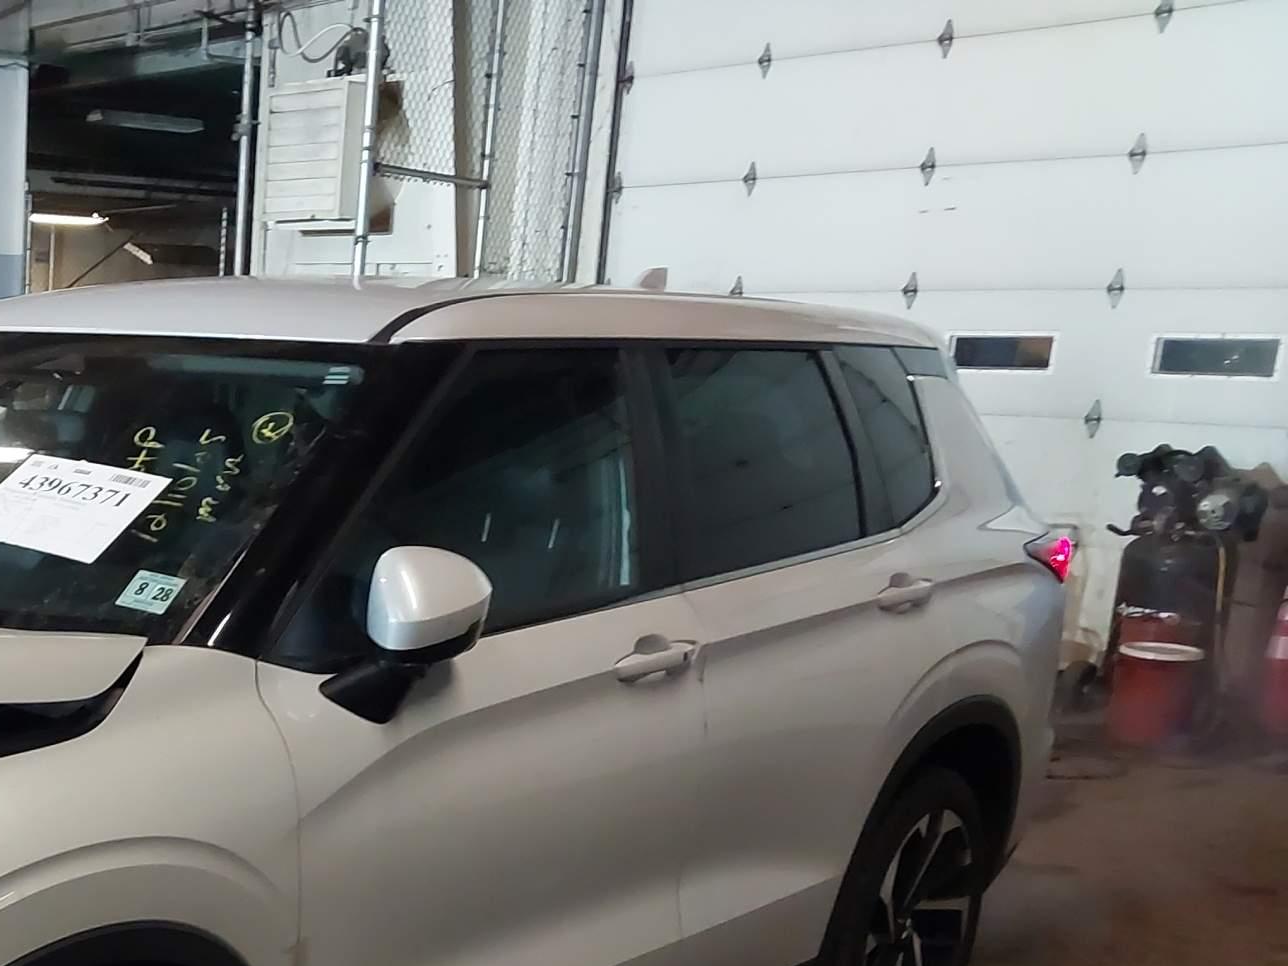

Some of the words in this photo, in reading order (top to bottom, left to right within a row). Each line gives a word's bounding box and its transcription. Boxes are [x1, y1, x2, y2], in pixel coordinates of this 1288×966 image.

[18, 473, 132, 508] 43967371
[133, 581, 150, 596] 8
[151, 586, 174, 602] 28
